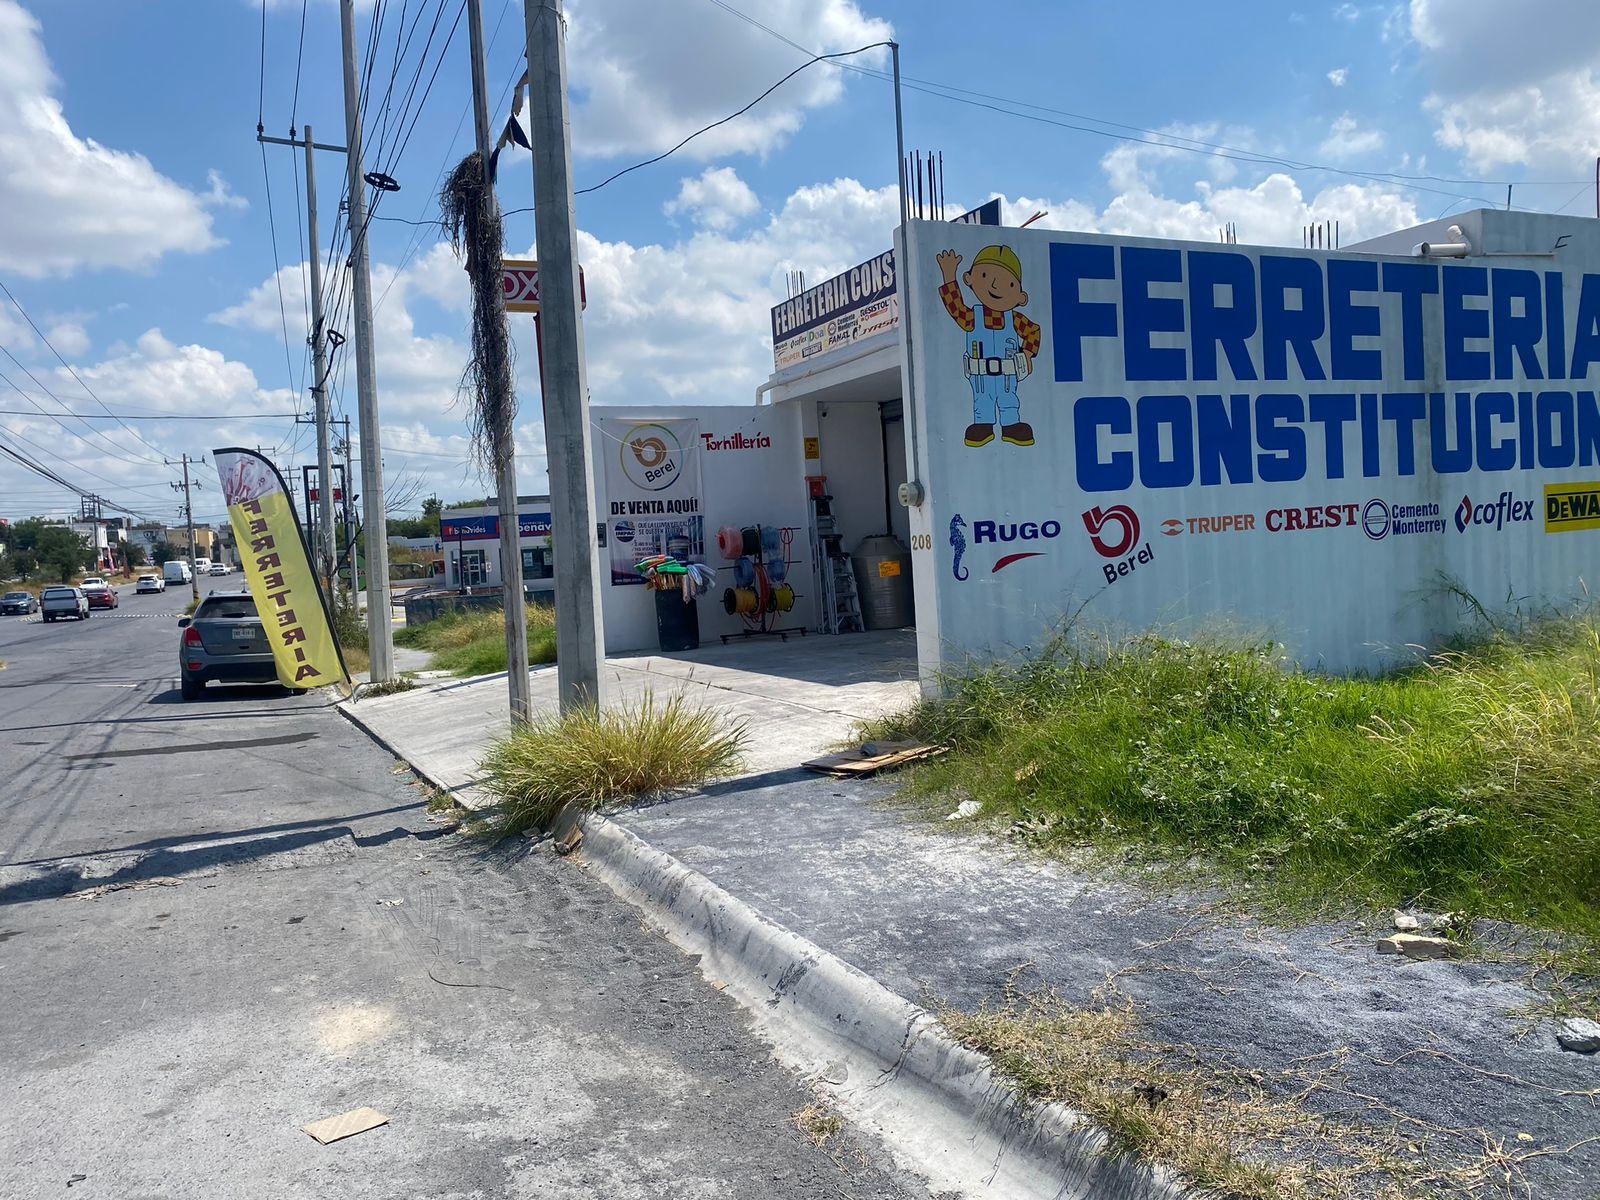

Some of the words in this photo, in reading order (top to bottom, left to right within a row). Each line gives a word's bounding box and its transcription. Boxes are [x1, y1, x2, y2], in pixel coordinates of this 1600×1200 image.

[774, 272, 849, 337] FERRETERIA
[851, 251, 896, 301] CONS
[1050, 243, 1600, 382] FERRETERIA
[1075, 392, 1600, 492] CONSTITUCION
[644, 459, 676, 483] Berel
[611, 501, 626, 515] DE
[627, 500, 664, 515] VENTA
[1267, 504, 1358, 530] CREST
[1391, 502, 1439, 520] Cemento
[1473, 491, 1535, 532] coflex
[974, 521, 1062, 545] RUGO
[1186, 513, 1256, 536] TRUPER
[1392, 518, 1448, 537] Monterrey
[911, 534, 932, 551] 208
[1102, 542, 1155, 585] Berel
